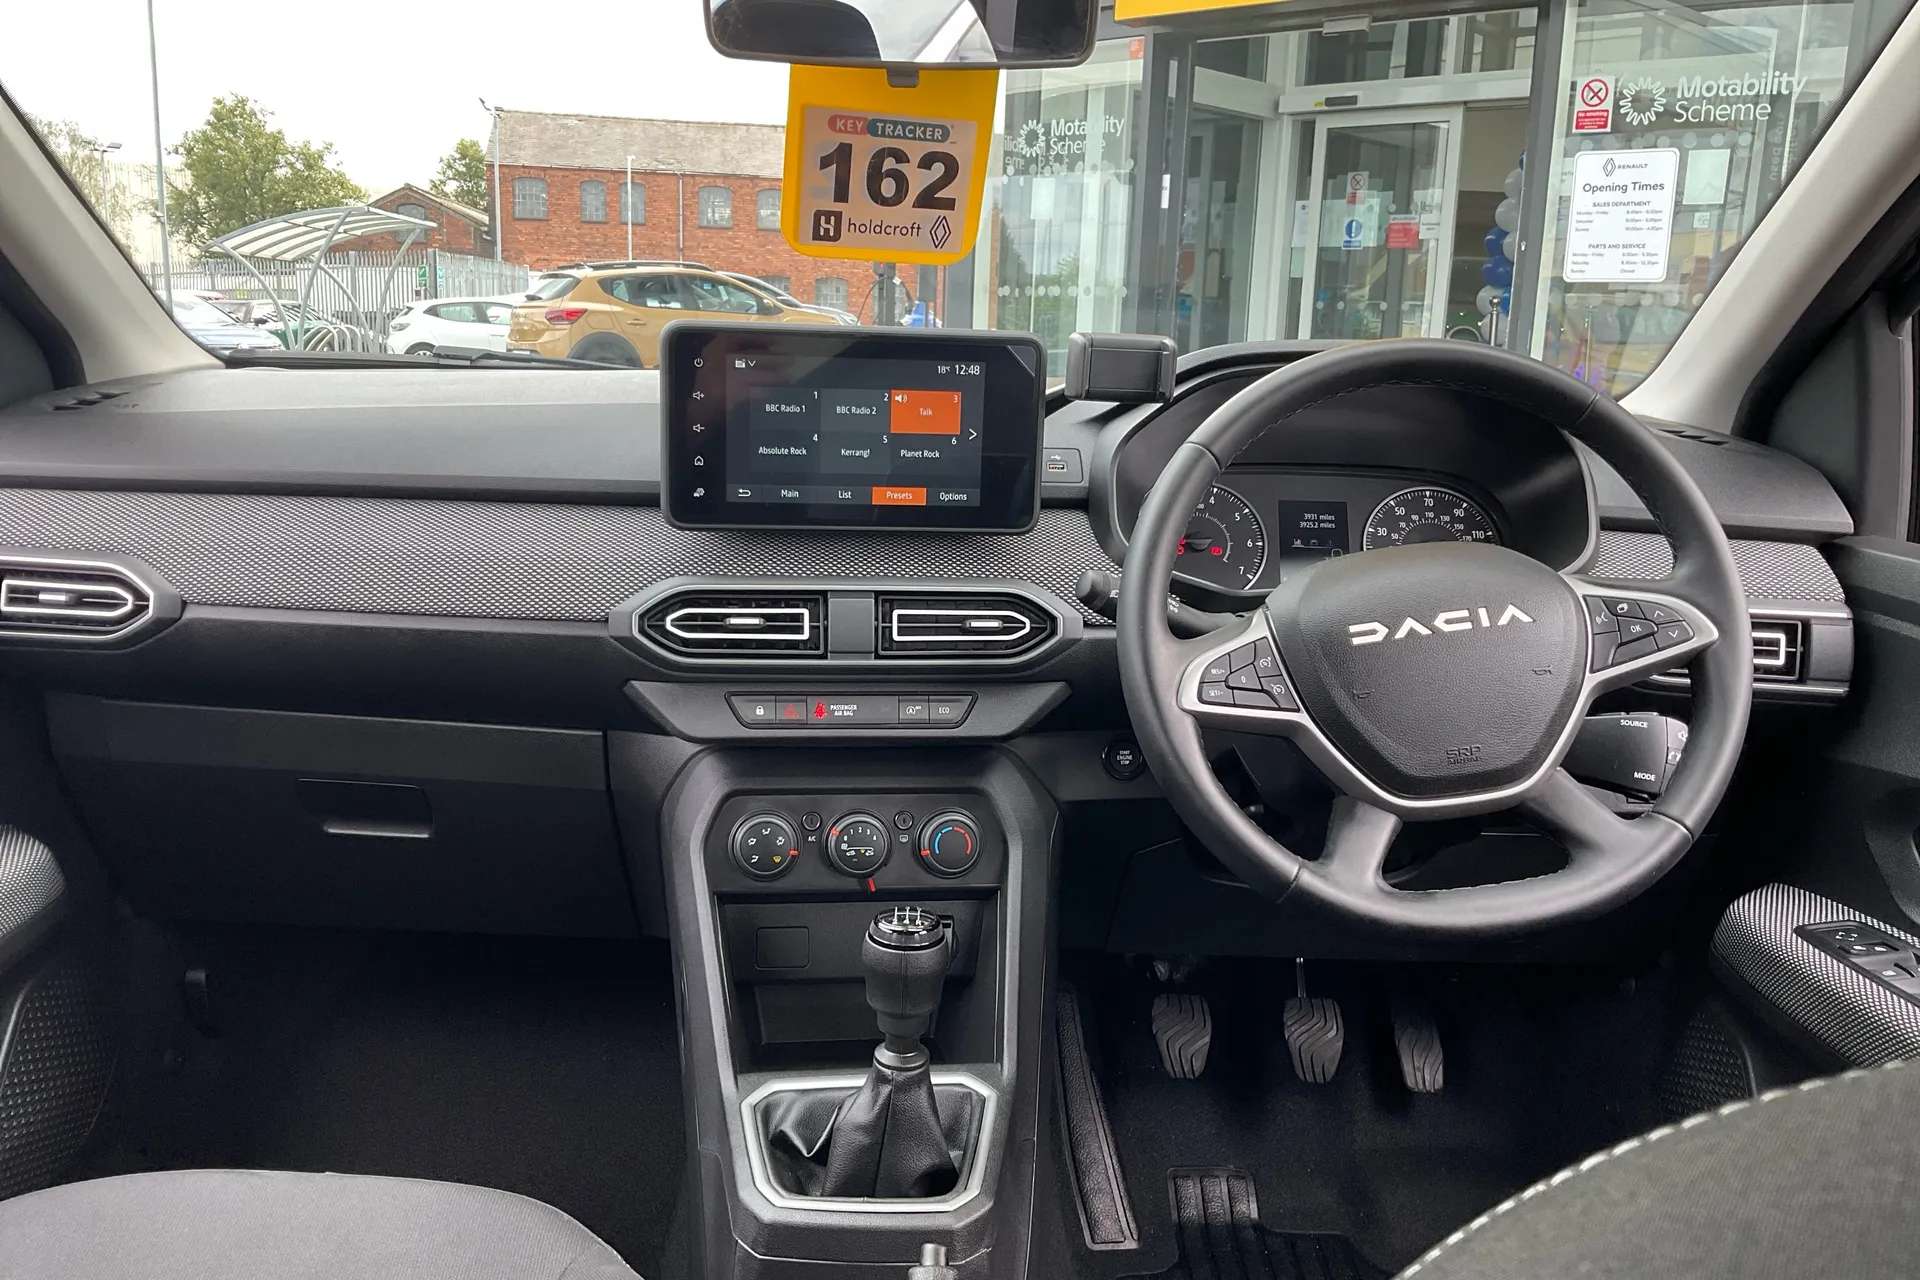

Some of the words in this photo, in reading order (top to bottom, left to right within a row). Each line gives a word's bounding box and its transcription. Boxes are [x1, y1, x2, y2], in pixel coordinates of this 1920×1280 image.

[1677, 70, 1808, 99] Motability
[1673, 100, 1771, 122] Scheme
[836, 117, 864, 133] KEY
[876, 122, 943, 140] TRACKER
[819, 142, 960, 211] 162
[1582, 182, 1628, 195] Opening
[1631, 181, 1665, 191] Times
[847, 218, 922, 238] holdcroft
[954, 365, 980, 376] 12:48
[814, 391, 818, 400] 1
[884, 393, 889, 402] 2
[953, 395, 958, 403] 3
[765, 404, 779, 412] BBC
[780, 404, 801, 413] Radio
[802, 405, 806, 413] 1
[836, 406, 850, 414] BBC
[851, 406, 870, 415] Radio
[871, 406, 877, 415] 2
[919, 408, 933, 416] Talk
[812, 433, 818, 442] 4
[882, 435, 888, 444] 5
[951, 437, 957, 445] 6
[758, 446, 789, 455] Absolute
[790, 446, 807, 456] Rock
[841, 449, 870, 458] Kerrang!
[900, 449, 922, 458] Planet
[923, 450, 940, 459] Rock
[781, 489, 799, 498] Main
[838, 489, 852, 499] List
[886, 491, 912, 500] Presets
[939, 491, 967, 502] Options
[1424, 498, 1434, 507] 70
[1395, 506, 1406, 516] 50
[1453, 508, 1465, 517] 90
[1234, 512, 1241, 521] 5
[1376, 527, 1388, 536] 30
[1472, 530, 1485, 540] 110
[1247, 538, 1253, 547] 6
[1239, 566, 1245, 575] 7
[1348, 603, 1535, 646] DACIA
[1630, 624, 1642, 633] OK
[938, 706, 950, 715] ECO
[1620, 719, 1648, 729] SOURCE
[1633, 771, 1656, 782] MODE
